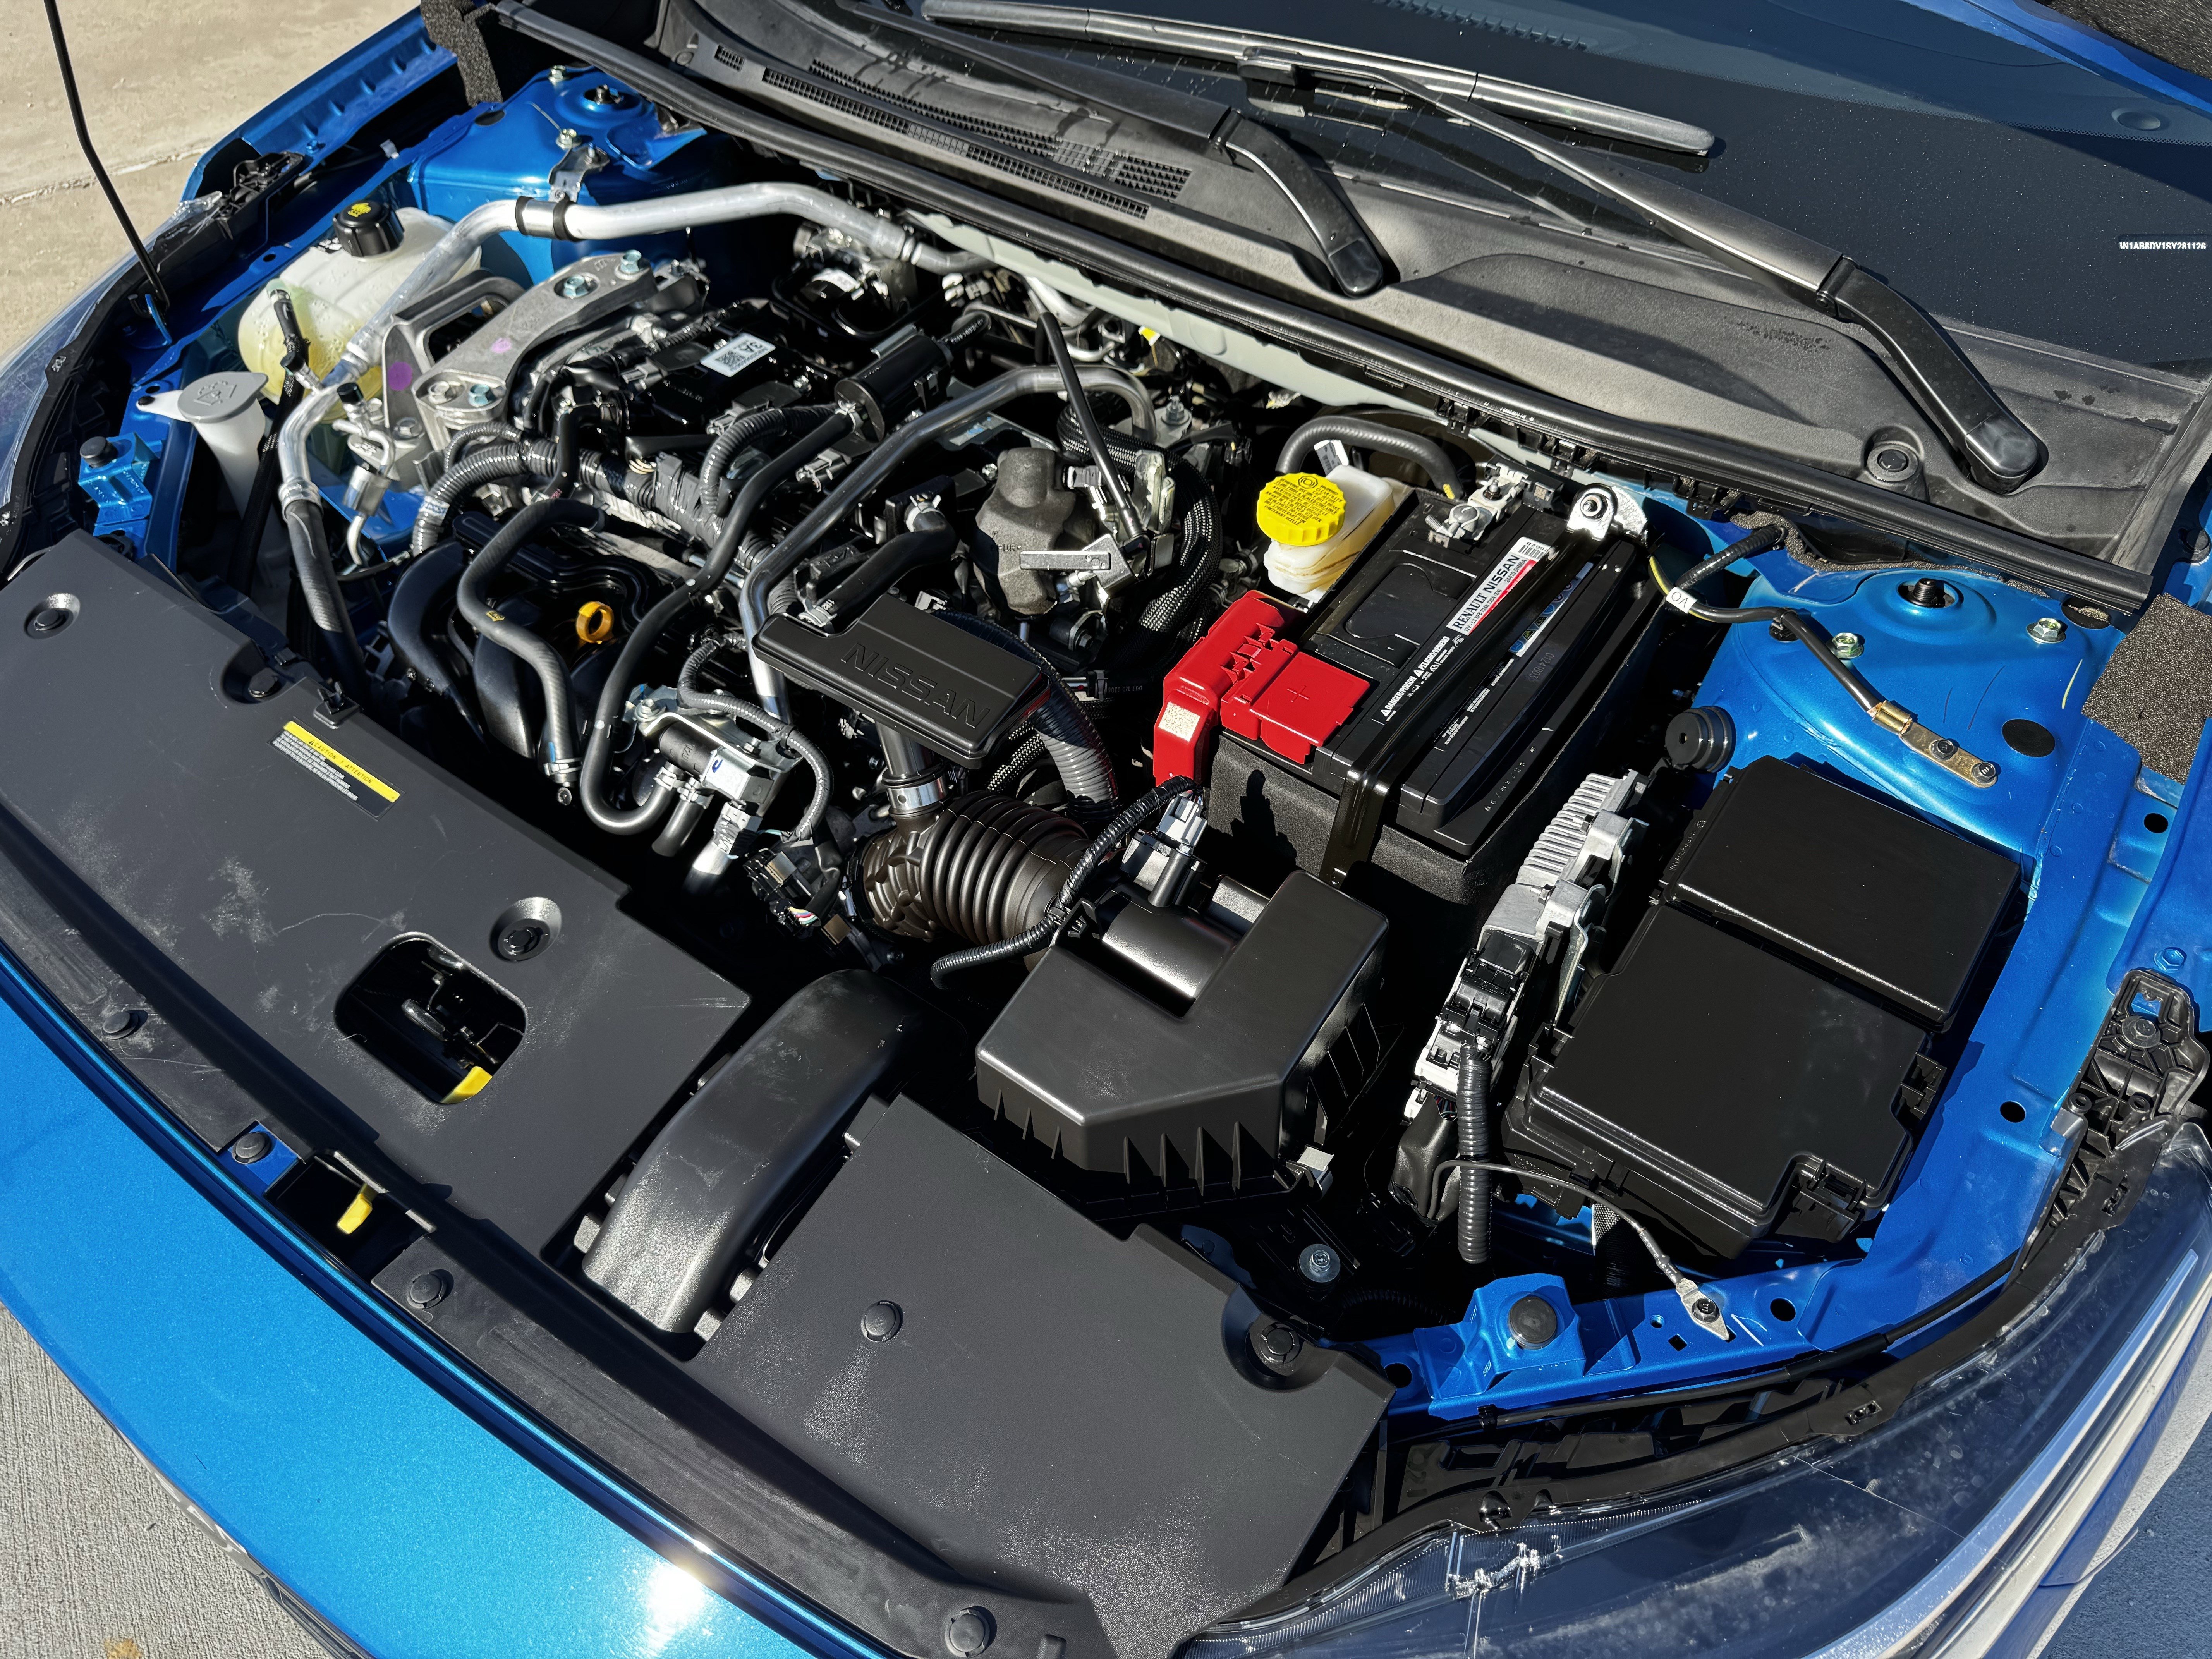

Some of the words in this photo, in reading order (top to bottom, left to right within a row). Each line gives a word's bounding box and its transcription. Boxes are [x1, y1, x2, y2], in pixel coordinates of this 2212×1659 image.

[1452, 593, 1487, 630] RENAULT
[1483, 555, 1520, 593] NISSAN
[841, 643, 990, 728] NISSAN
[314, 743, 337, 760] CAUTION
[345, 764, 373, 783] ATTENTION
